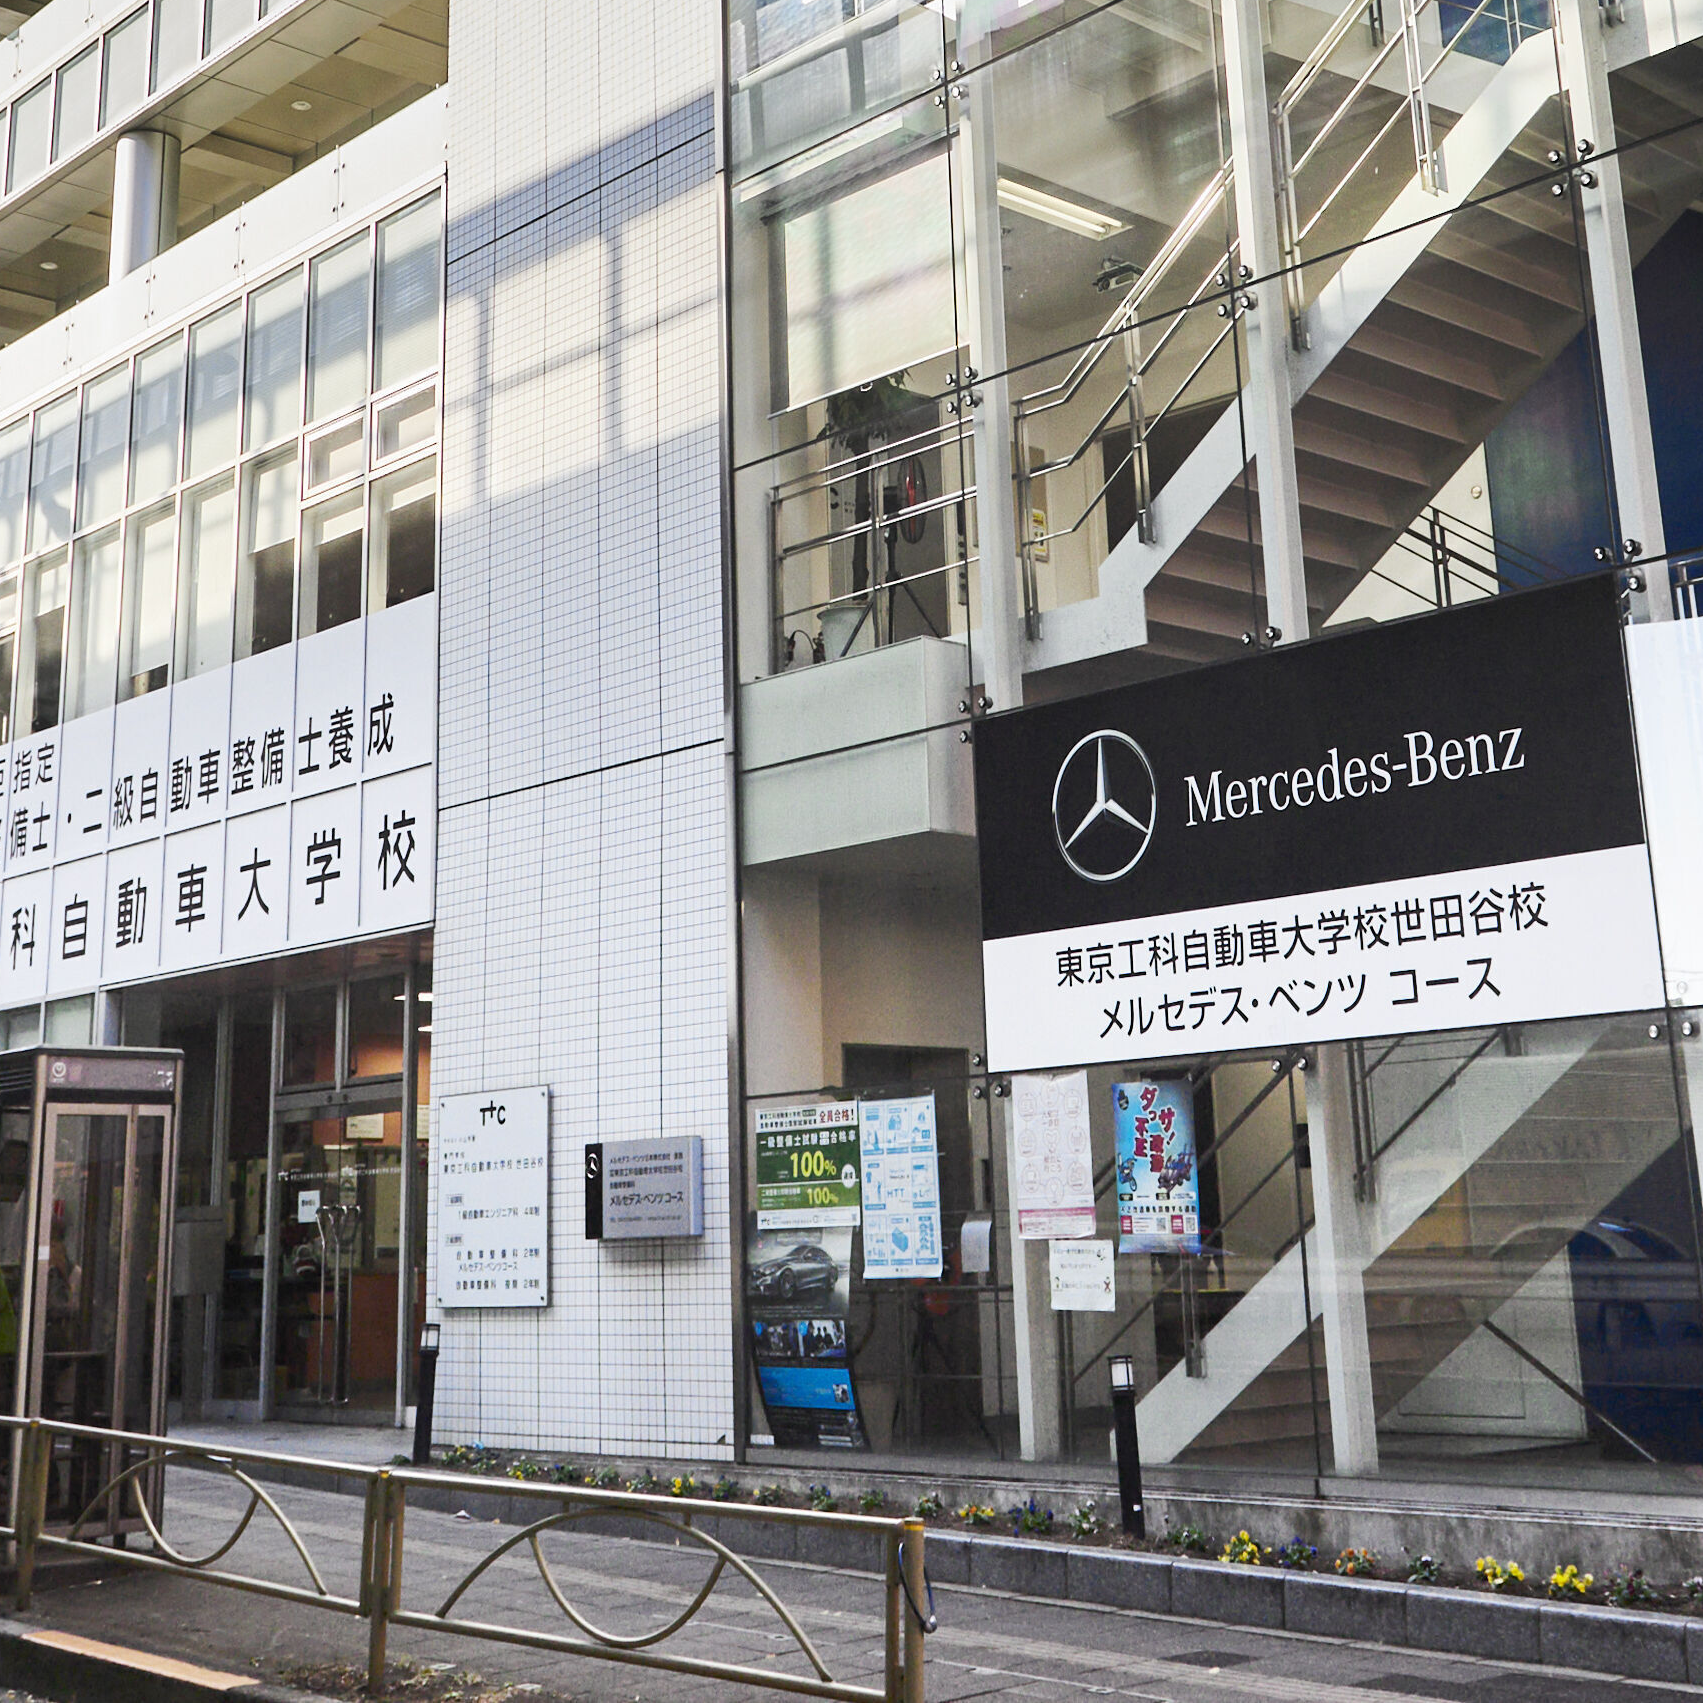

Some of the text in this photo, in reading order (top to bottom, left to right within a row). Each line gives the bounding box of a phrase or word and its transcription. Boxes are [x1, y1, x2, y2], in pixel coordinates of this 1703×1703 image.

[1185, 726, 1526, 828] Mercedes-Benz
[1055, 882, 1550, 989] 東京工科自動車大学校世田谷校
[1098, 956, 1502, 1040] メルセデス・ベンツ コース
[790, 1150, 837, 1178] 100%
